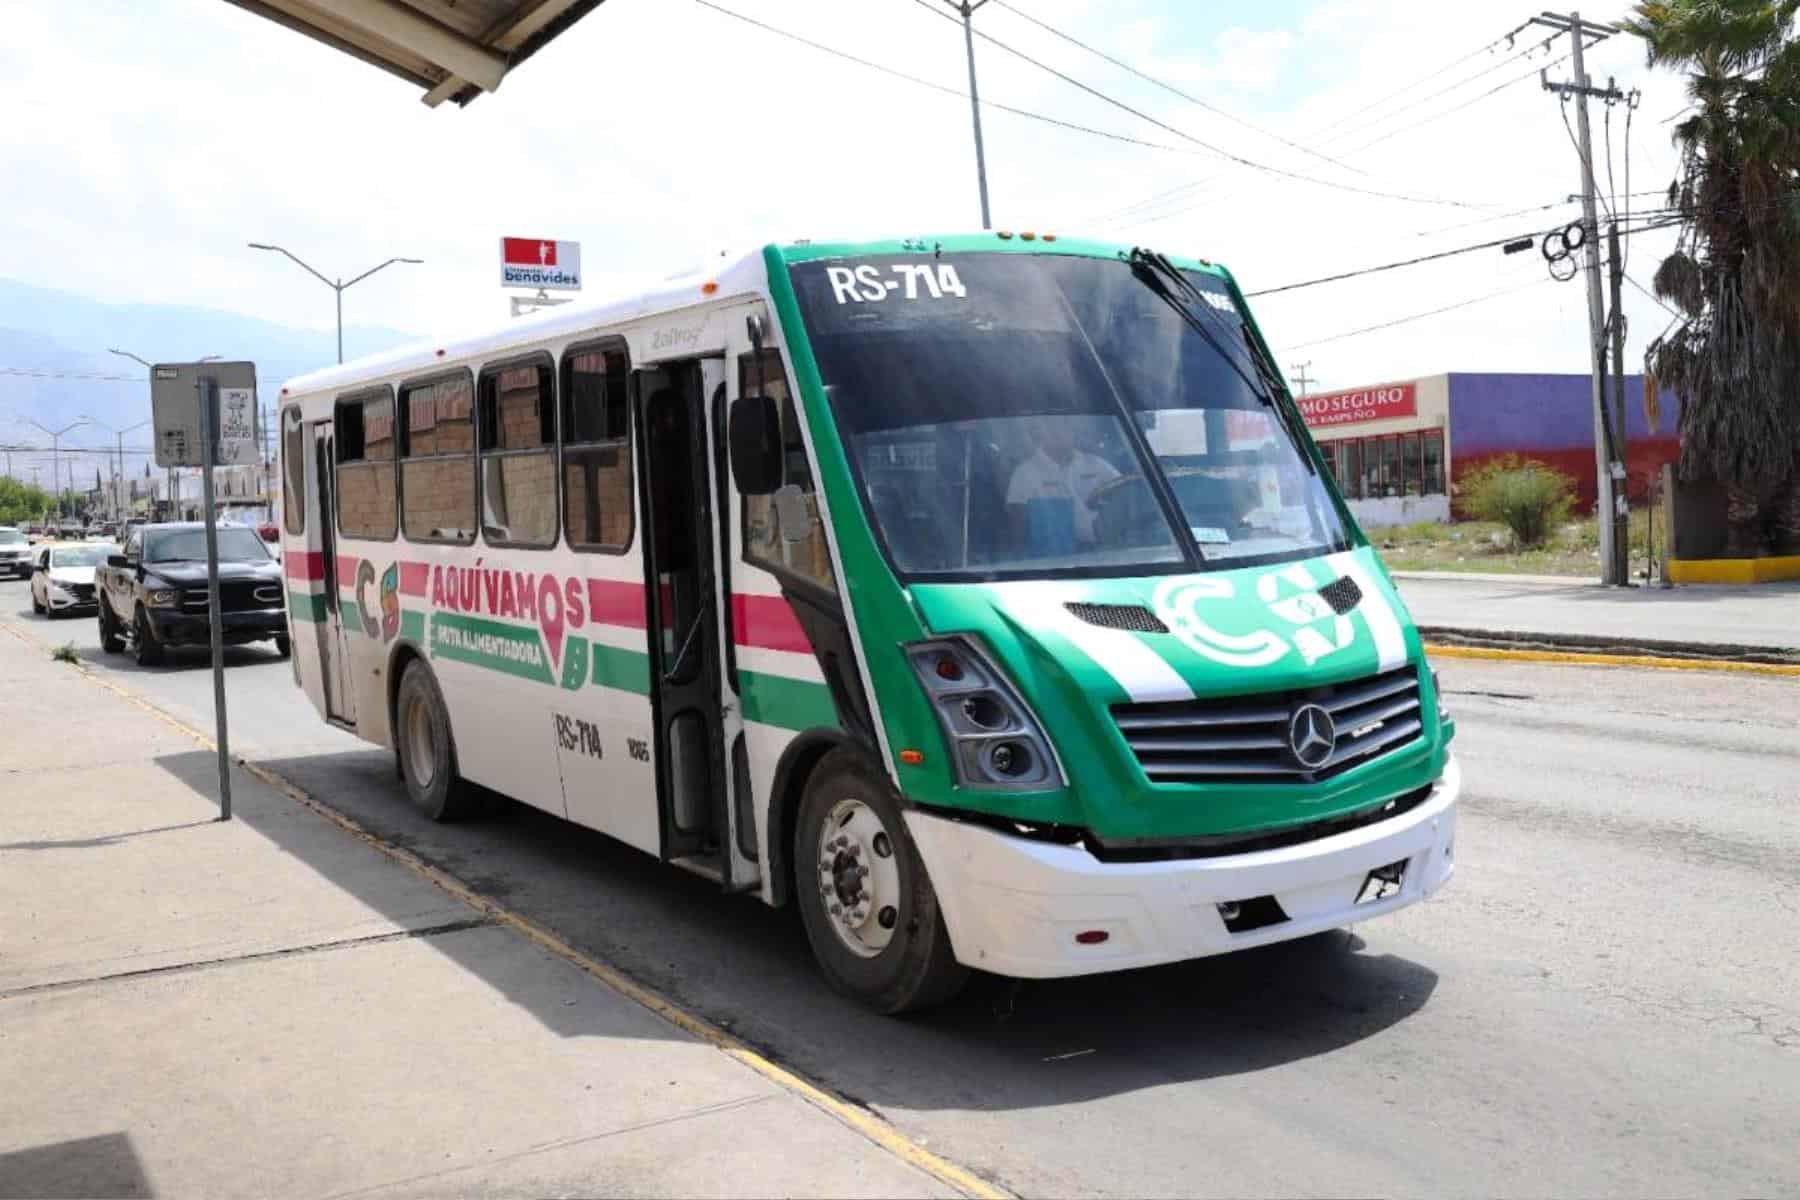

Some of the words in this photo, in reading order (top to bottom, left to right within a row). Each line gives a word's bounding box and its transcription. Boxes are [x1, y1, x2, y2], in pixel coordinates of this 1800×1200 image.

[504, 267, 579, 285] benavides
[826, 264, 967, 304] RS-714
[1331, 387, 1403, 412] SEGURO
[1320, 409, 1377, 424] EMPEÑO
[463, 629, 543, 667] ALIMENTADORA
[556, 713, 603, 760] RS-714
